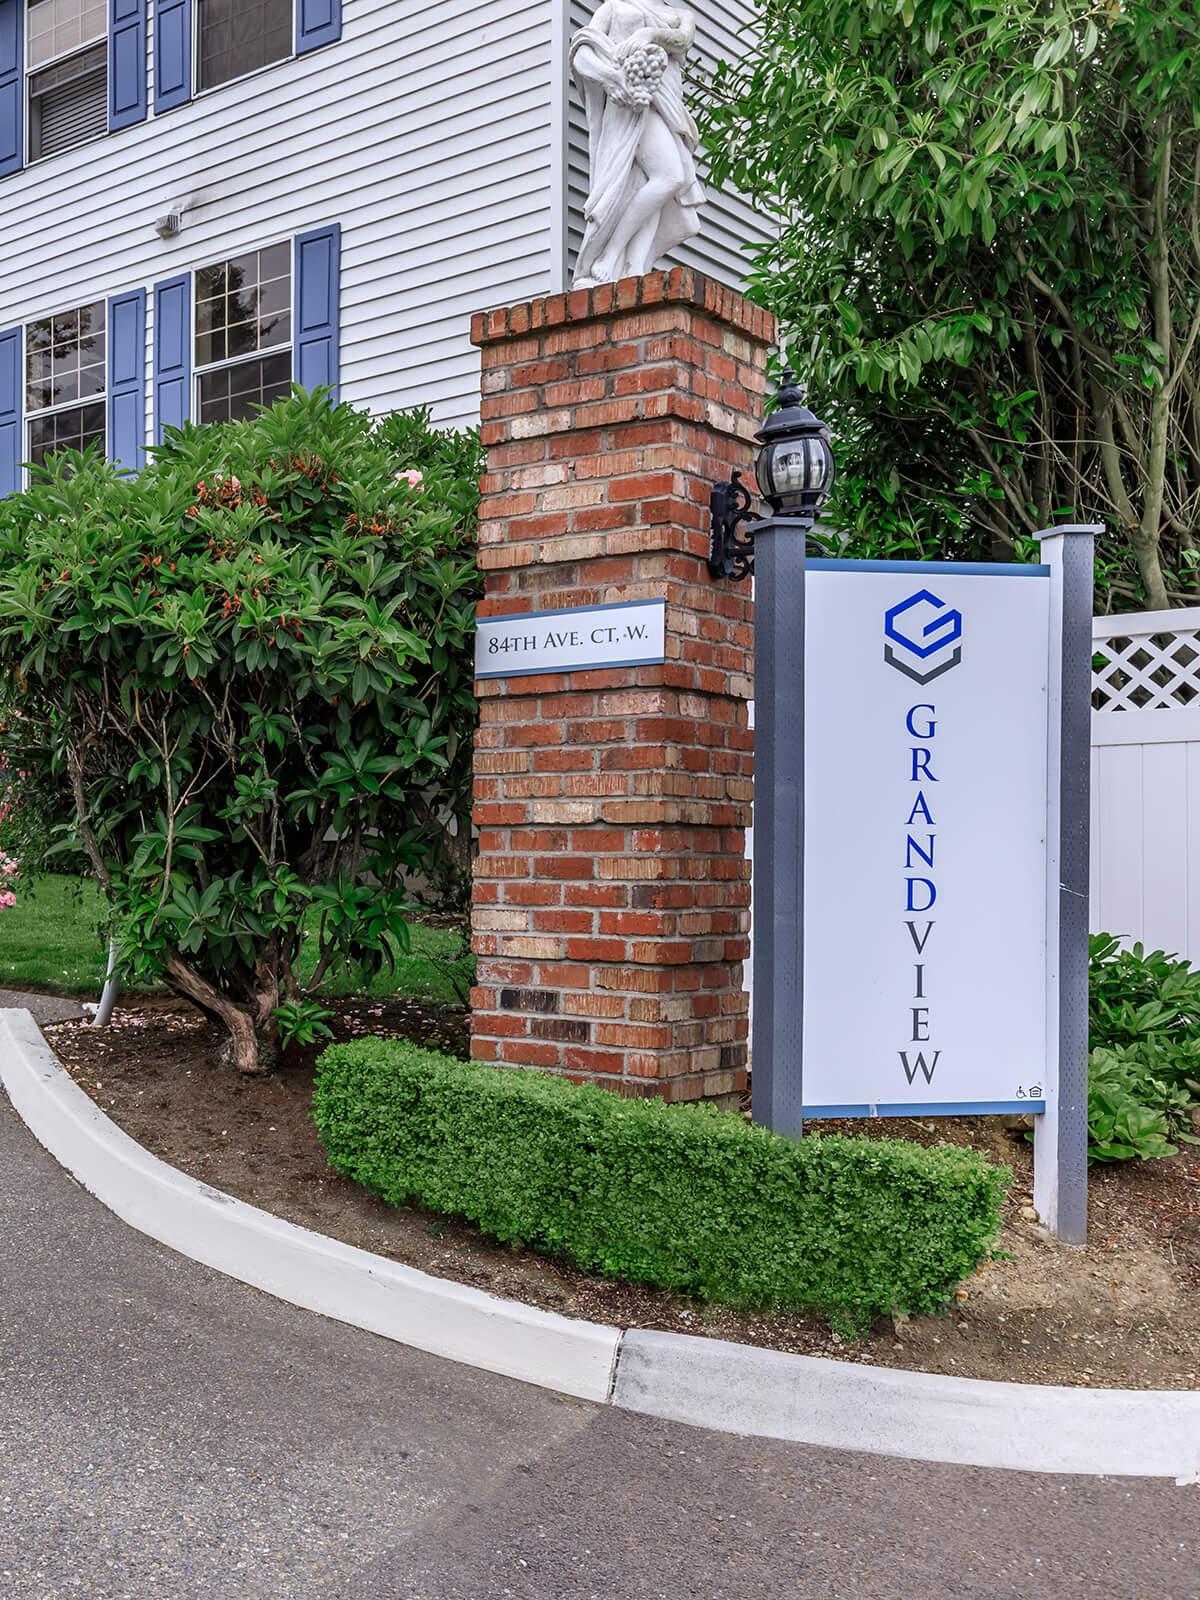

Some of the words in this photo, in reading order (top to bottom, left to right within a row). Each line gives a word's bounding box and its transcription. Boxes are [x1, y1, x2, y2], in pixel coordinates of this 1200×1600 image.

[488, 635, 537, 655] 84TH
[543, 631, 584, 649] AVE.
[626, 624, 649, 641] W.
[897, 703, 942, 1086] GRANDVIEW
